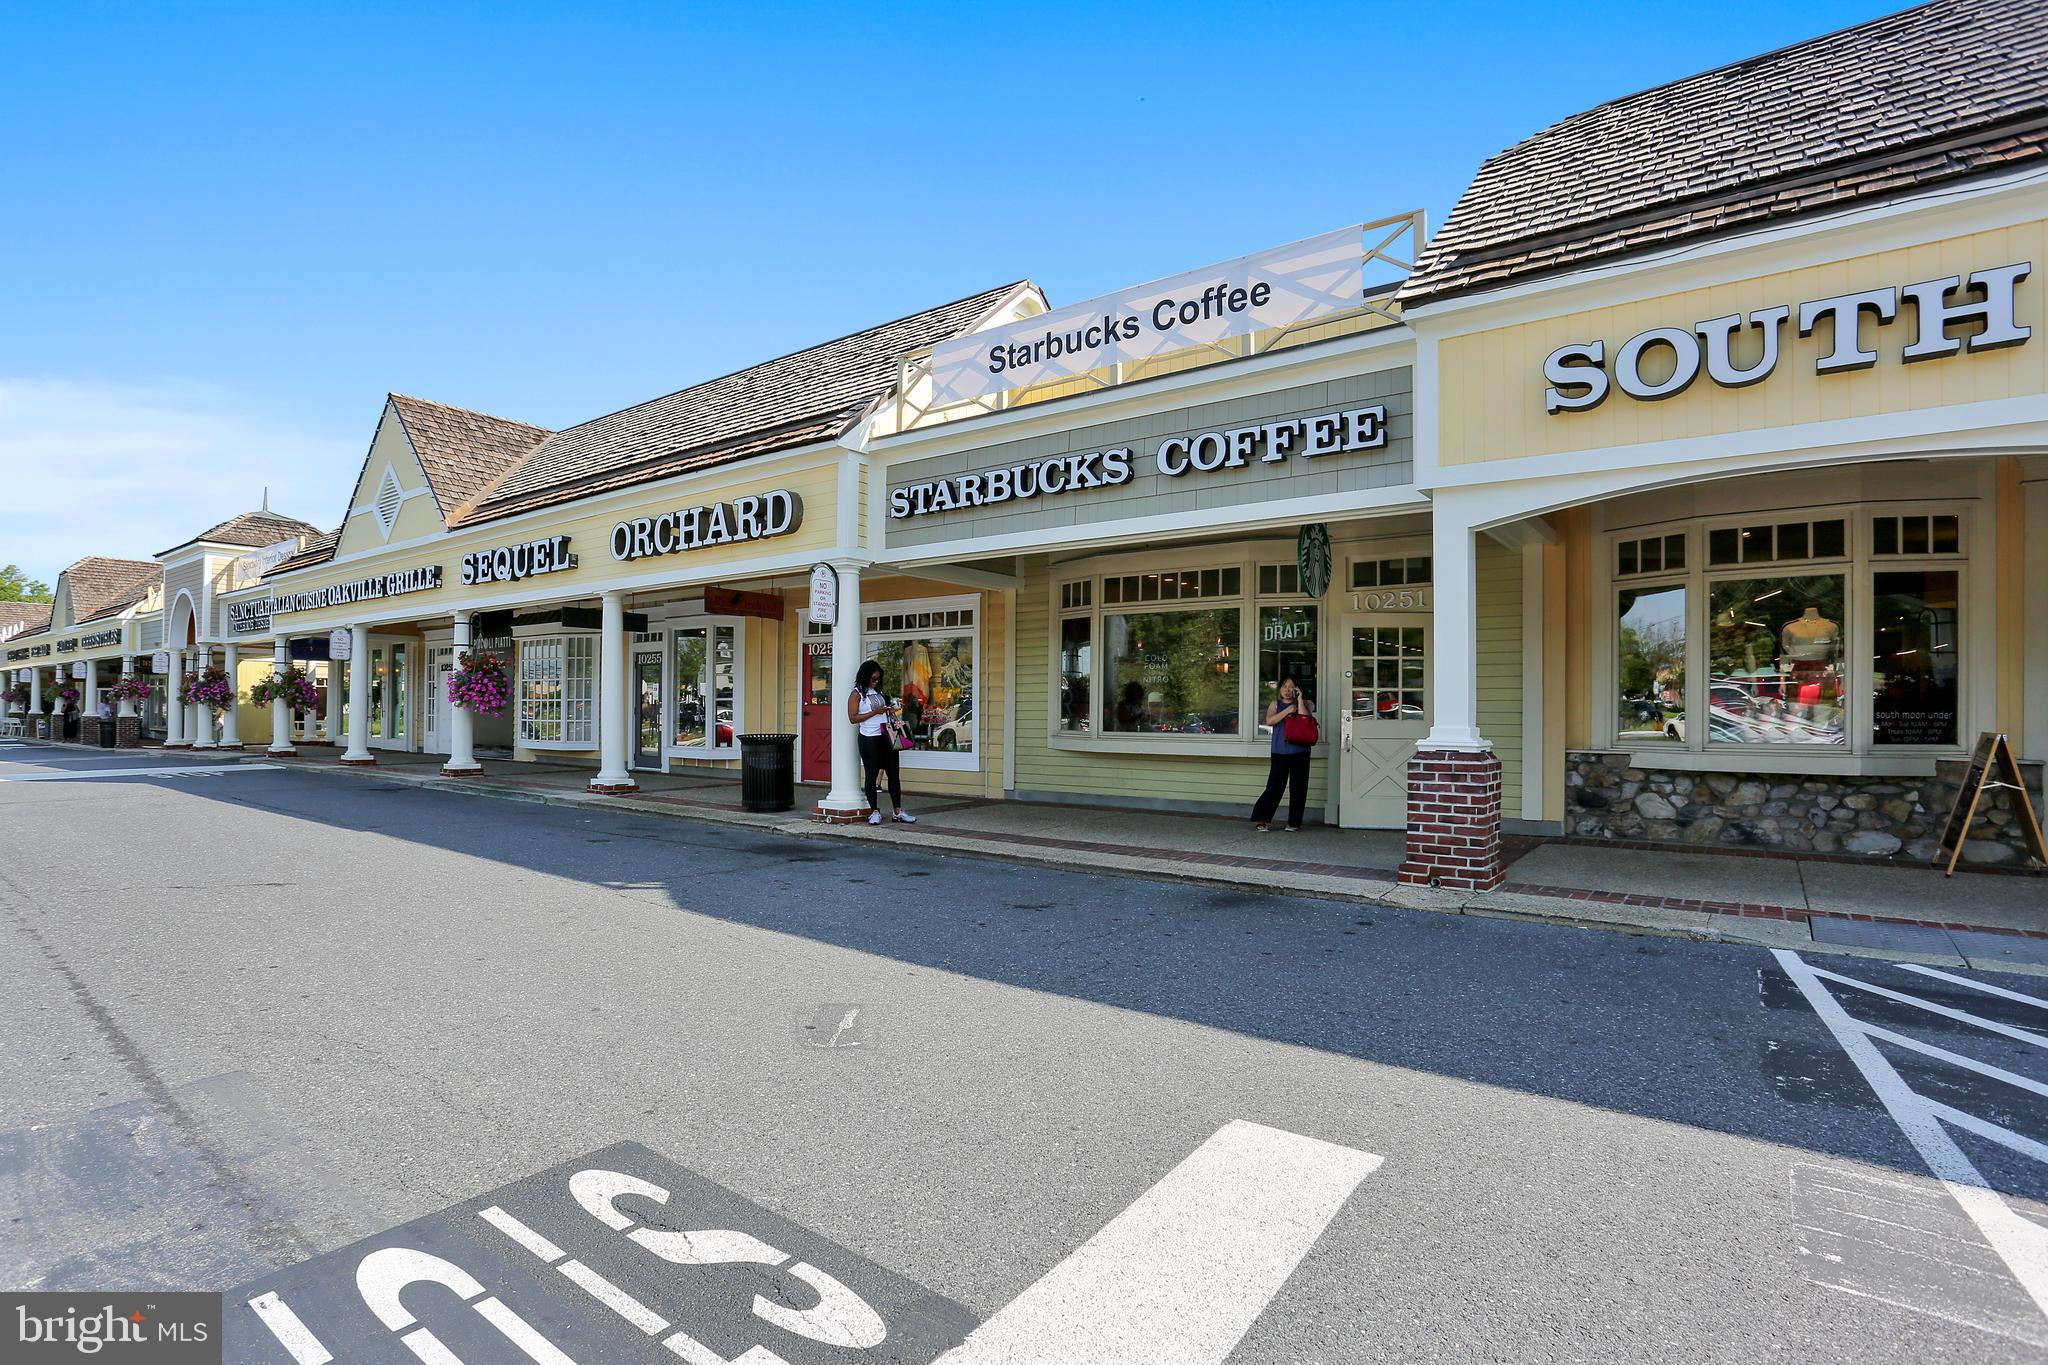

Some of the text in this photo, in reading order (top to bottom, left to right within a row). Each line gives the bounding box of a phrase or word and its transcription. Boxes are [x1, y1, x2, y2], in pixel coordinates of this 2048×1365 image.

[988, 282, 1271, 374] Starbucks Coffee
[1543, 261, 2032, 415] SOUTH
[890, 405, 1387, 519] STARBUCKS COFFEE
[610, 488, 798, 562] ORCHARD
[461, 534, 577, 586] SEQUEL
[295, 589, 327, 612] CUISINE
[328, 576, 383, 605] OAKVILLE
[386, 565, 438, 597] GRILLE
[1351, 589, 1427, 612] 10251
[1263, 621, 1310, 642] DRAFT
[637, 652, 662, 664] 10255
[808, 643, 833, 656] 1025
[1144, 654, 1168, 662] COLD
[1144, 662, 1168, 670] FOAM
[1143, 675, 1169, 683] NITRO
[1876, 711, 1900, 719] south
[1928, 710, 1953, 719] under
